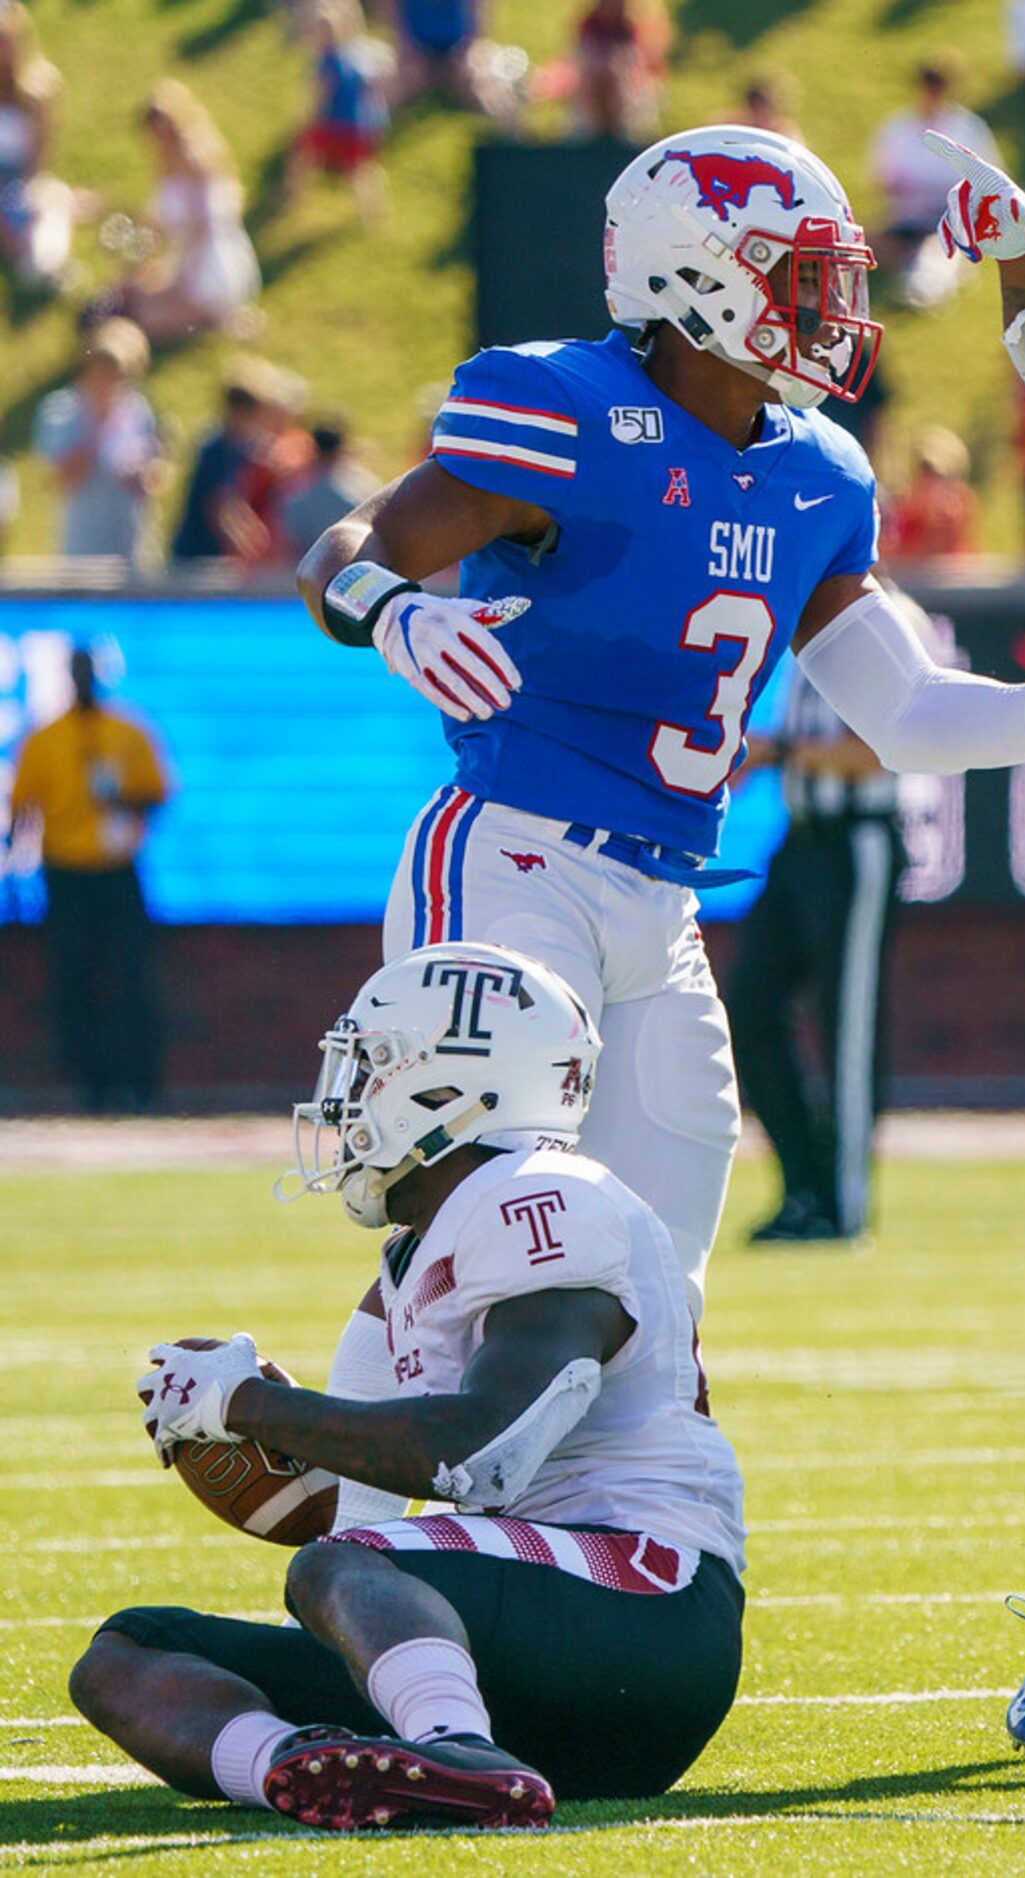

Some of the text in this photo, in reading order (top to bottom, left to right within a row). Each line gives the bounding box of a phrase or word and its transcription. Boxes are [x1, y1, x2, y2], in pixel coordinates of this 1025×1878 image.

[608, 405, 664, 445] 150
[662, 467, 691, 507] A
[708, 521, 776, 583] SMU
[647, 589, 776, 798] 3
[422, 960, 523, 1057] T
[500, 1190, 566, 1266] T
